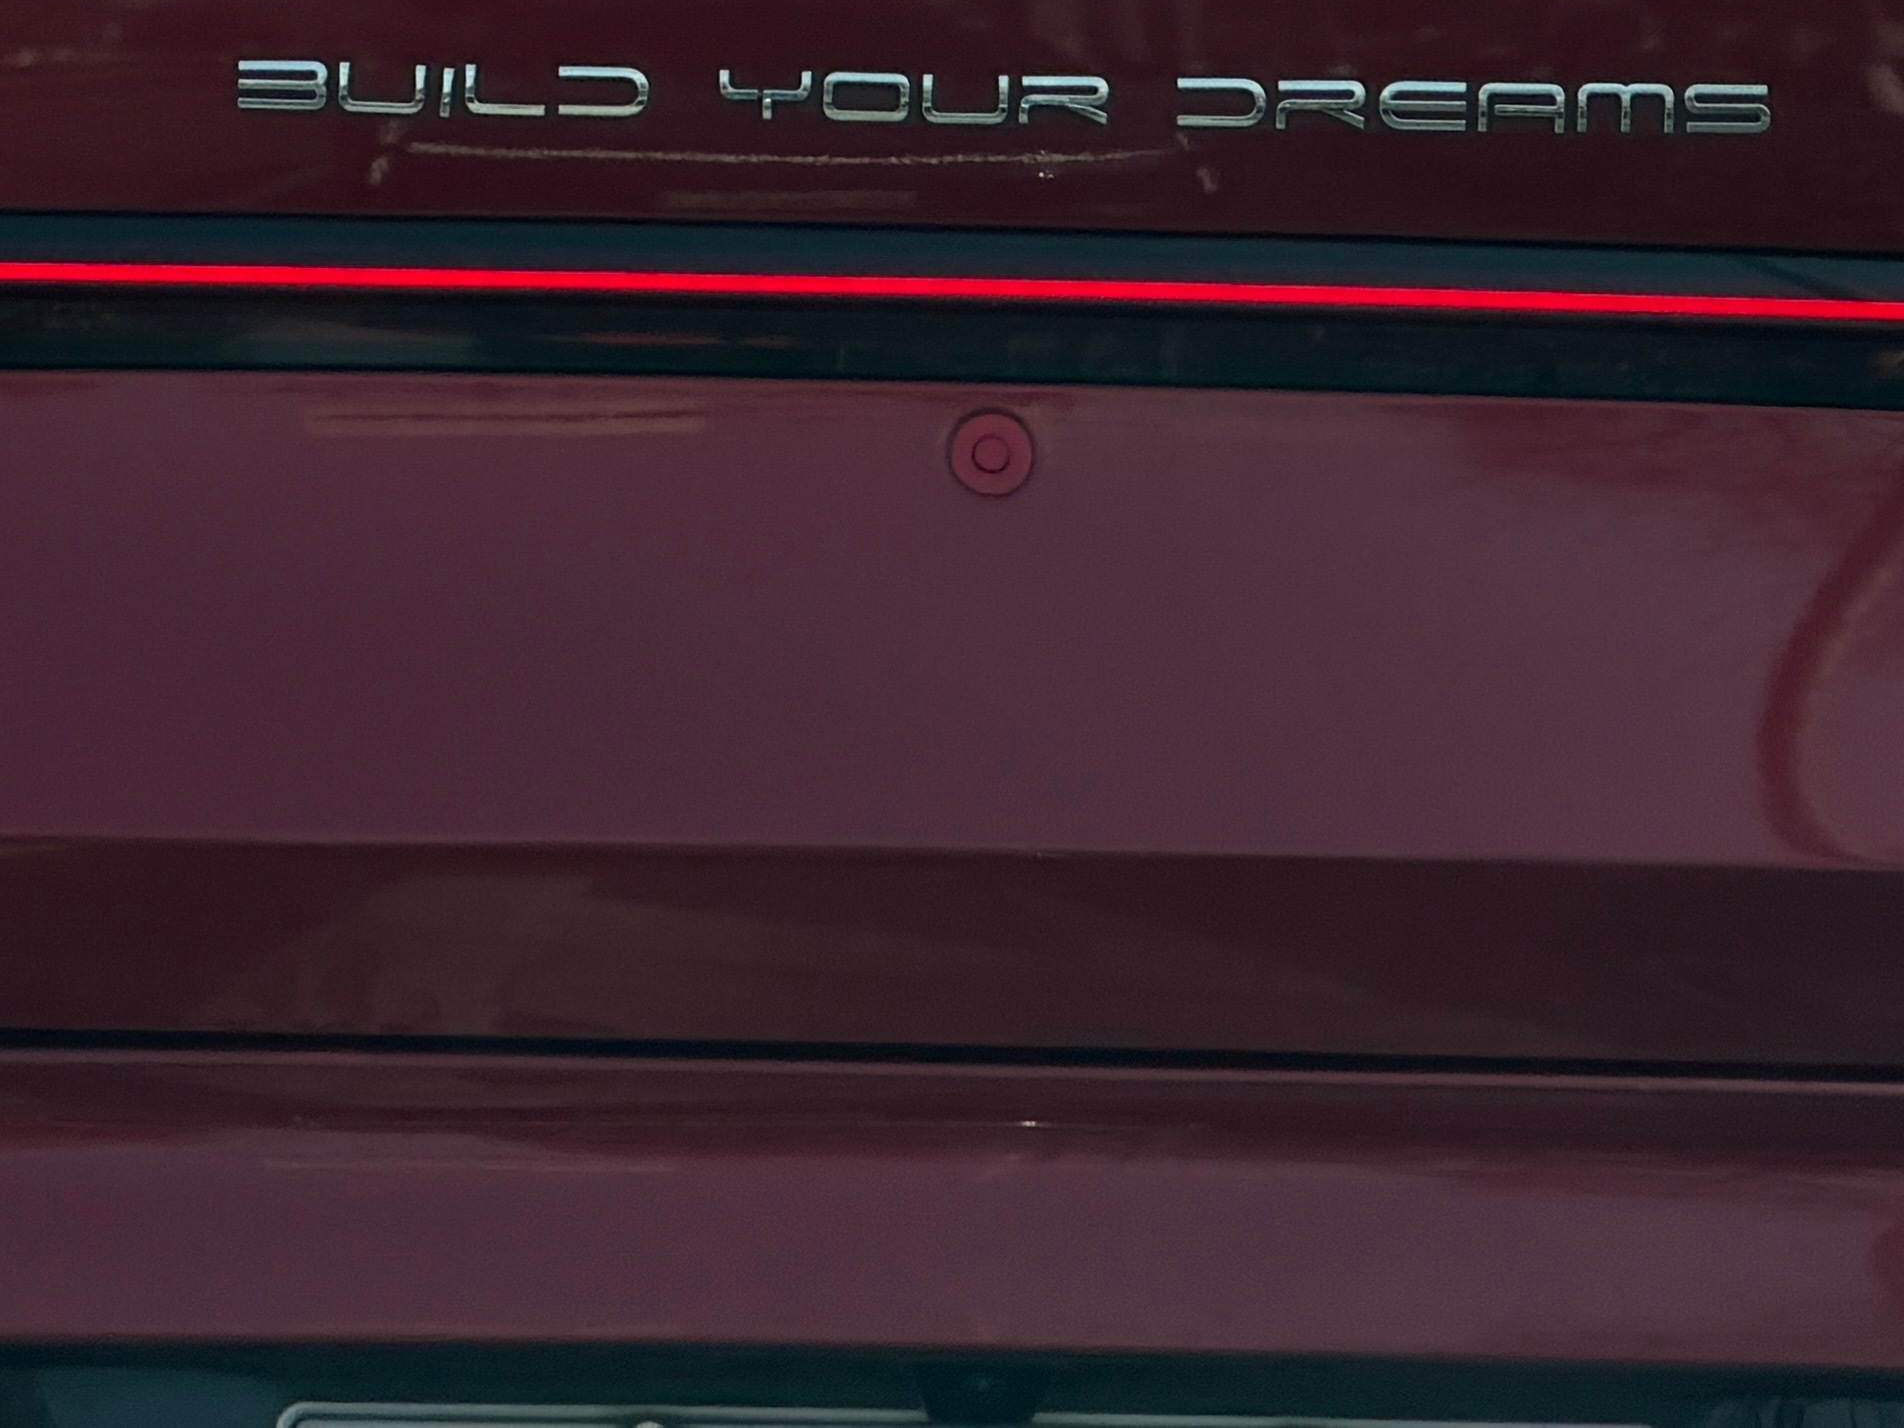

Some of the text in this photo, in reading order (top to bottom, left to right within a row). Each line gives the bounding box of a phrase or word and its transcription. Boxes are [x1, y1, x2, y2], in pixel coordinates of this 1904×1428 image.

[237, 58, 1771, 134] BUILD YOUR DREAMS
